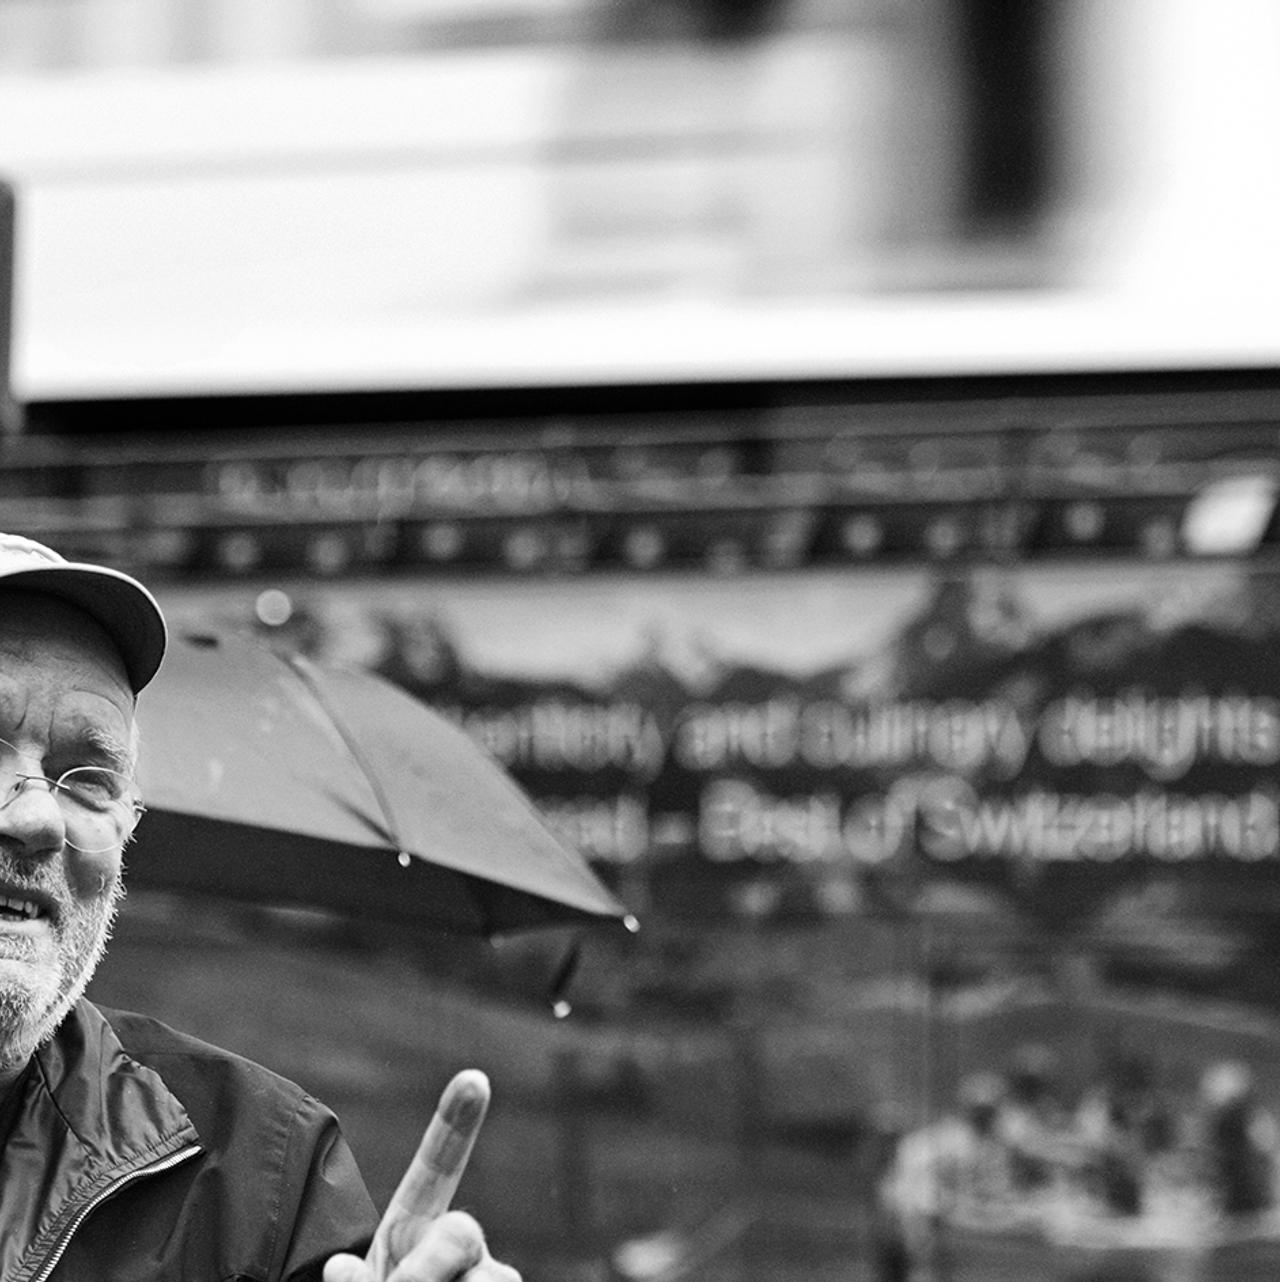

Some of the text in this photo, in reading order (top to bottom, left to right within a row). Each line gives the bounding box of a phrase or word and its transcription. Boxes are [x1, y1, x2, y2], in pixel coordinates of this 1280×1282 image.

[675, 700, 800, 768] and
[801, 702, 1027, 780] culinary
[701, 780, 841, 862] Best
[844, 780, 922, 862] of
